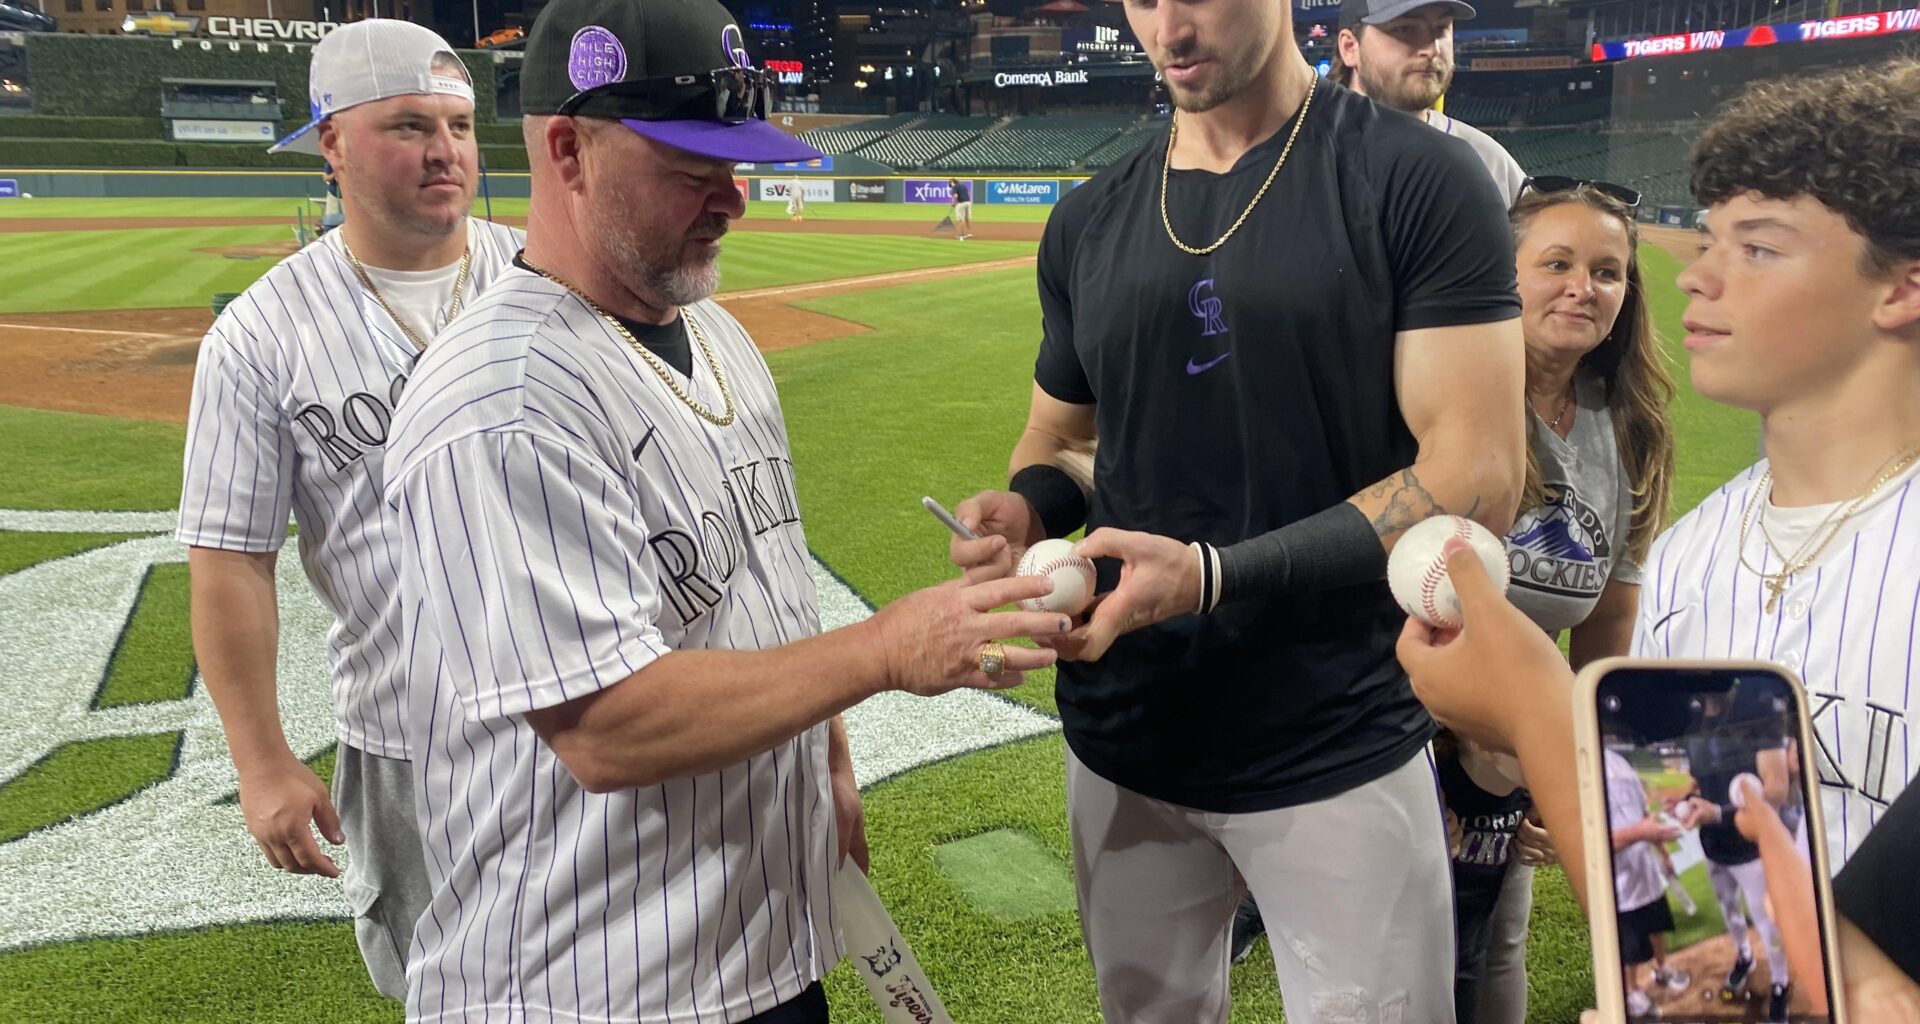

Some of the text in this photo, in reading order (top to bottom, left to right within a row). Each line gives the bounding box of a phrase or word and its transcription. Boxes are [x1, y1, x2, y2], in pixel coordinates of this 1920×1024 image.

[208, 17, 339, 39] CHEVRO
[1800, 15, 1879, 38] TIGERS
[1095, 26, 1119, 43] Lite
[172, 39, 317, 54] FOUNT
[578, 42, 614, 53] MILE
[1077, 43, 1118, 51] PITCHER'S
[1624, 30, 1725, 57] TIGERS WIN
[578, 55, 613, 68] HIGH
[577, 70, 611, 82] CITY
[778, 71, 804, 84] LAW
[1055, 70, 1088, 84] Bank
[782, 116, 794, 127] 42
[806, 189, 829, 197] SION
[915, 183, 953, 201] xfinit
[1009, 183, 1050, 195] McLaren
[1508, 549, 1609, 591] OCKIES
